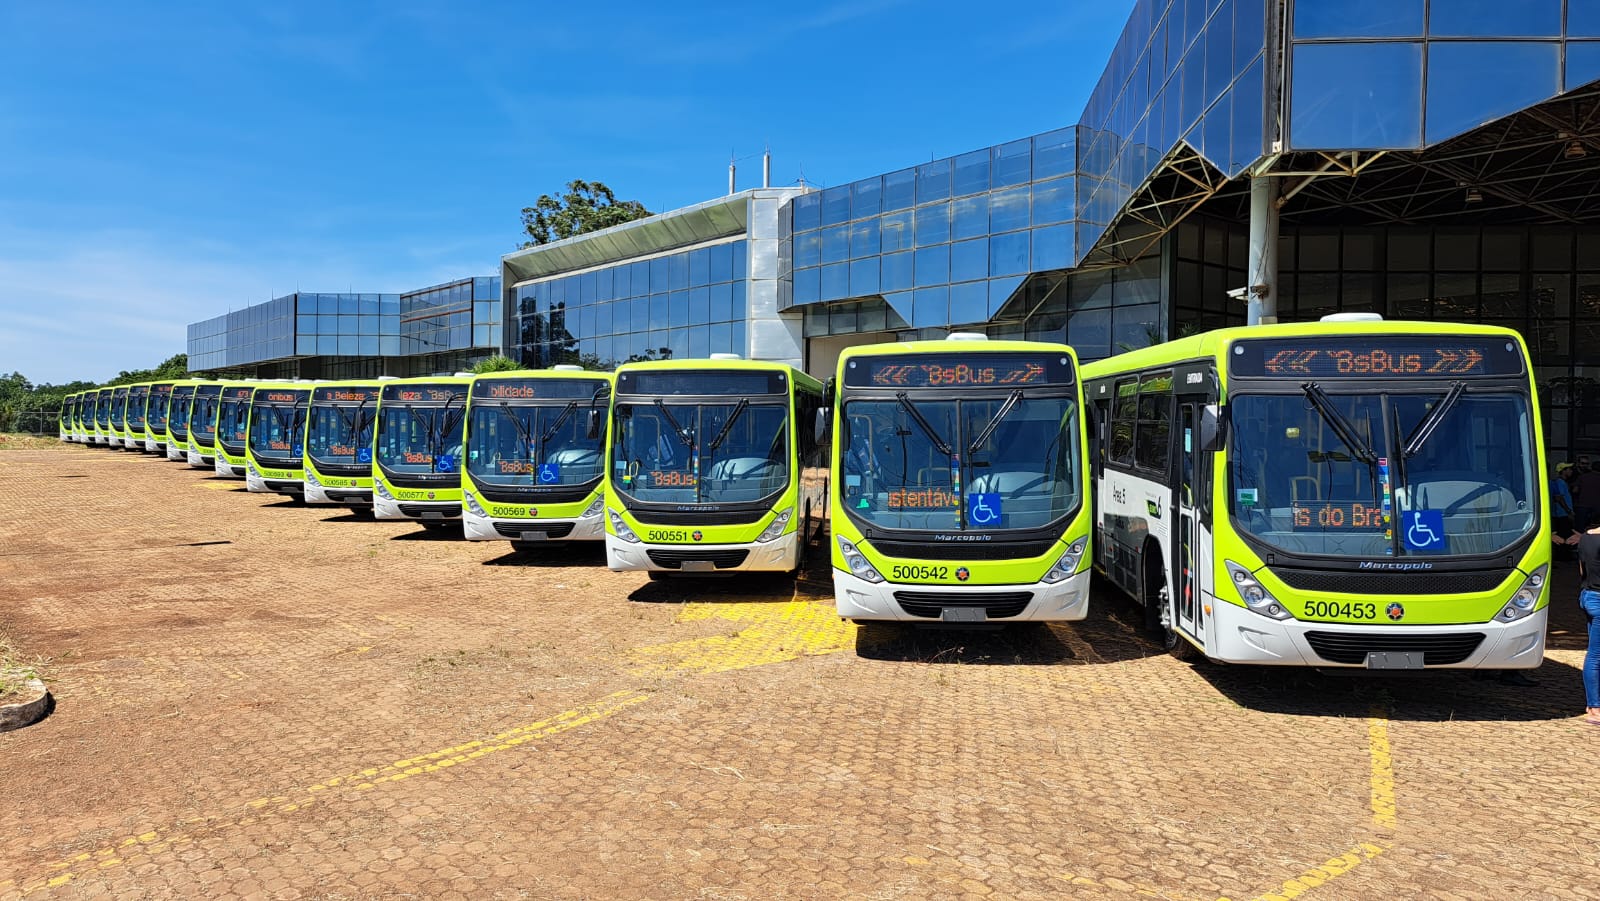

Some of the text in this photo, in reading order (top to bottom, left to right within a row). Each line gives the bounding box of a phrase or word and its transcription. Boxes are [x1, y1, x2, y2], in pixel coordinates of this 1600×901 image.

[1326, 349, 1422, 373] BsBus
[920, 364, 996, 384] BsBus
[404, 452, 432, 463] BsBus
[498, 460, 534, 473] BsBus
[650, 471, 694, 486] BsBus
[397, 491, 425, 499] 500577
[1122, 487, 1126, 505] 5
[492, 506, 526, 516] 500569
[1318, 503, 1345, 526] do
[648, 530, 688, 541] 500551
[934, 534, 992, 542] Marcopolo
[892, 565, 948, 580] 500542
[1359, 561, 1433, 571] Marcopolo
[1303, 600, 1377, 620] 500453
